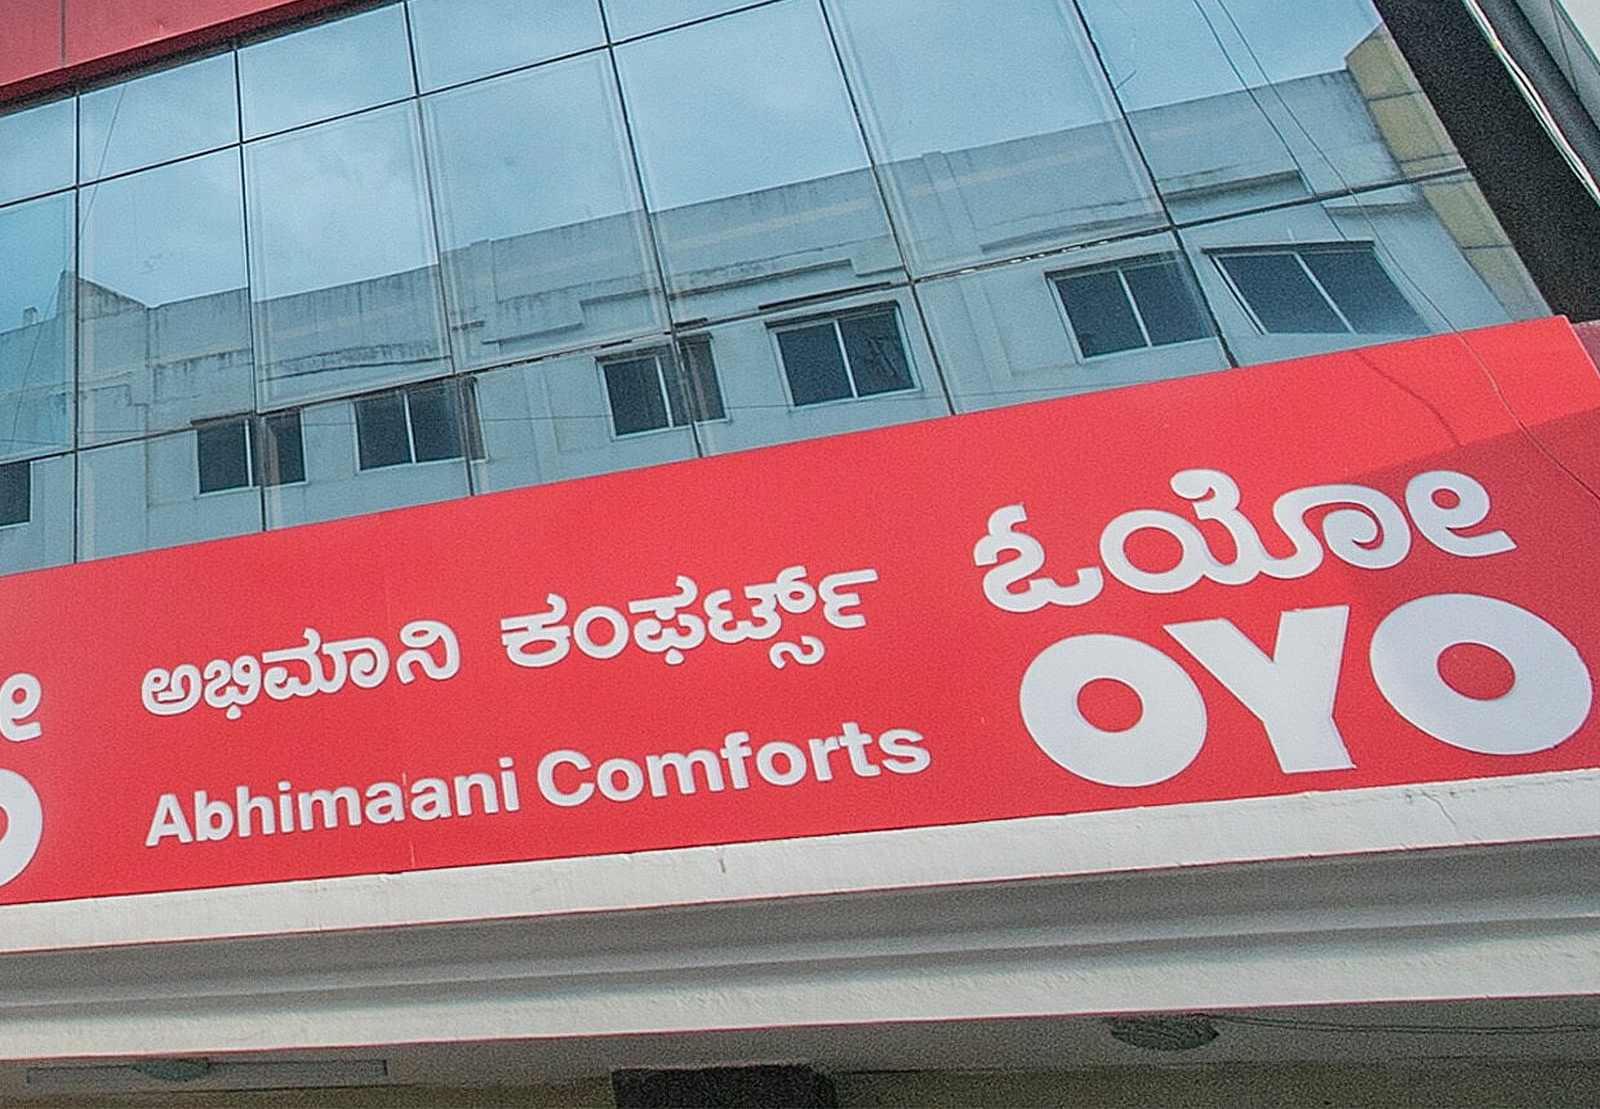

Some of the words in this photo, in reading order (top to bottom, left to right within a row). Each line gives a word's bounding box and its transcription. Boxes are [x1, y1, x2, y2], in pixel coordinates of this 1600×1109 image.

[973, 468, 1518, 613] ಓಯೋ
[141, 620, 460, 720] ಅಭಿಮಾನಿ
[1019, 593, 1593, 787] OYO
[145, 756, 520, 847] Abhimaani
[537, 722, 931, 807] Comforts
